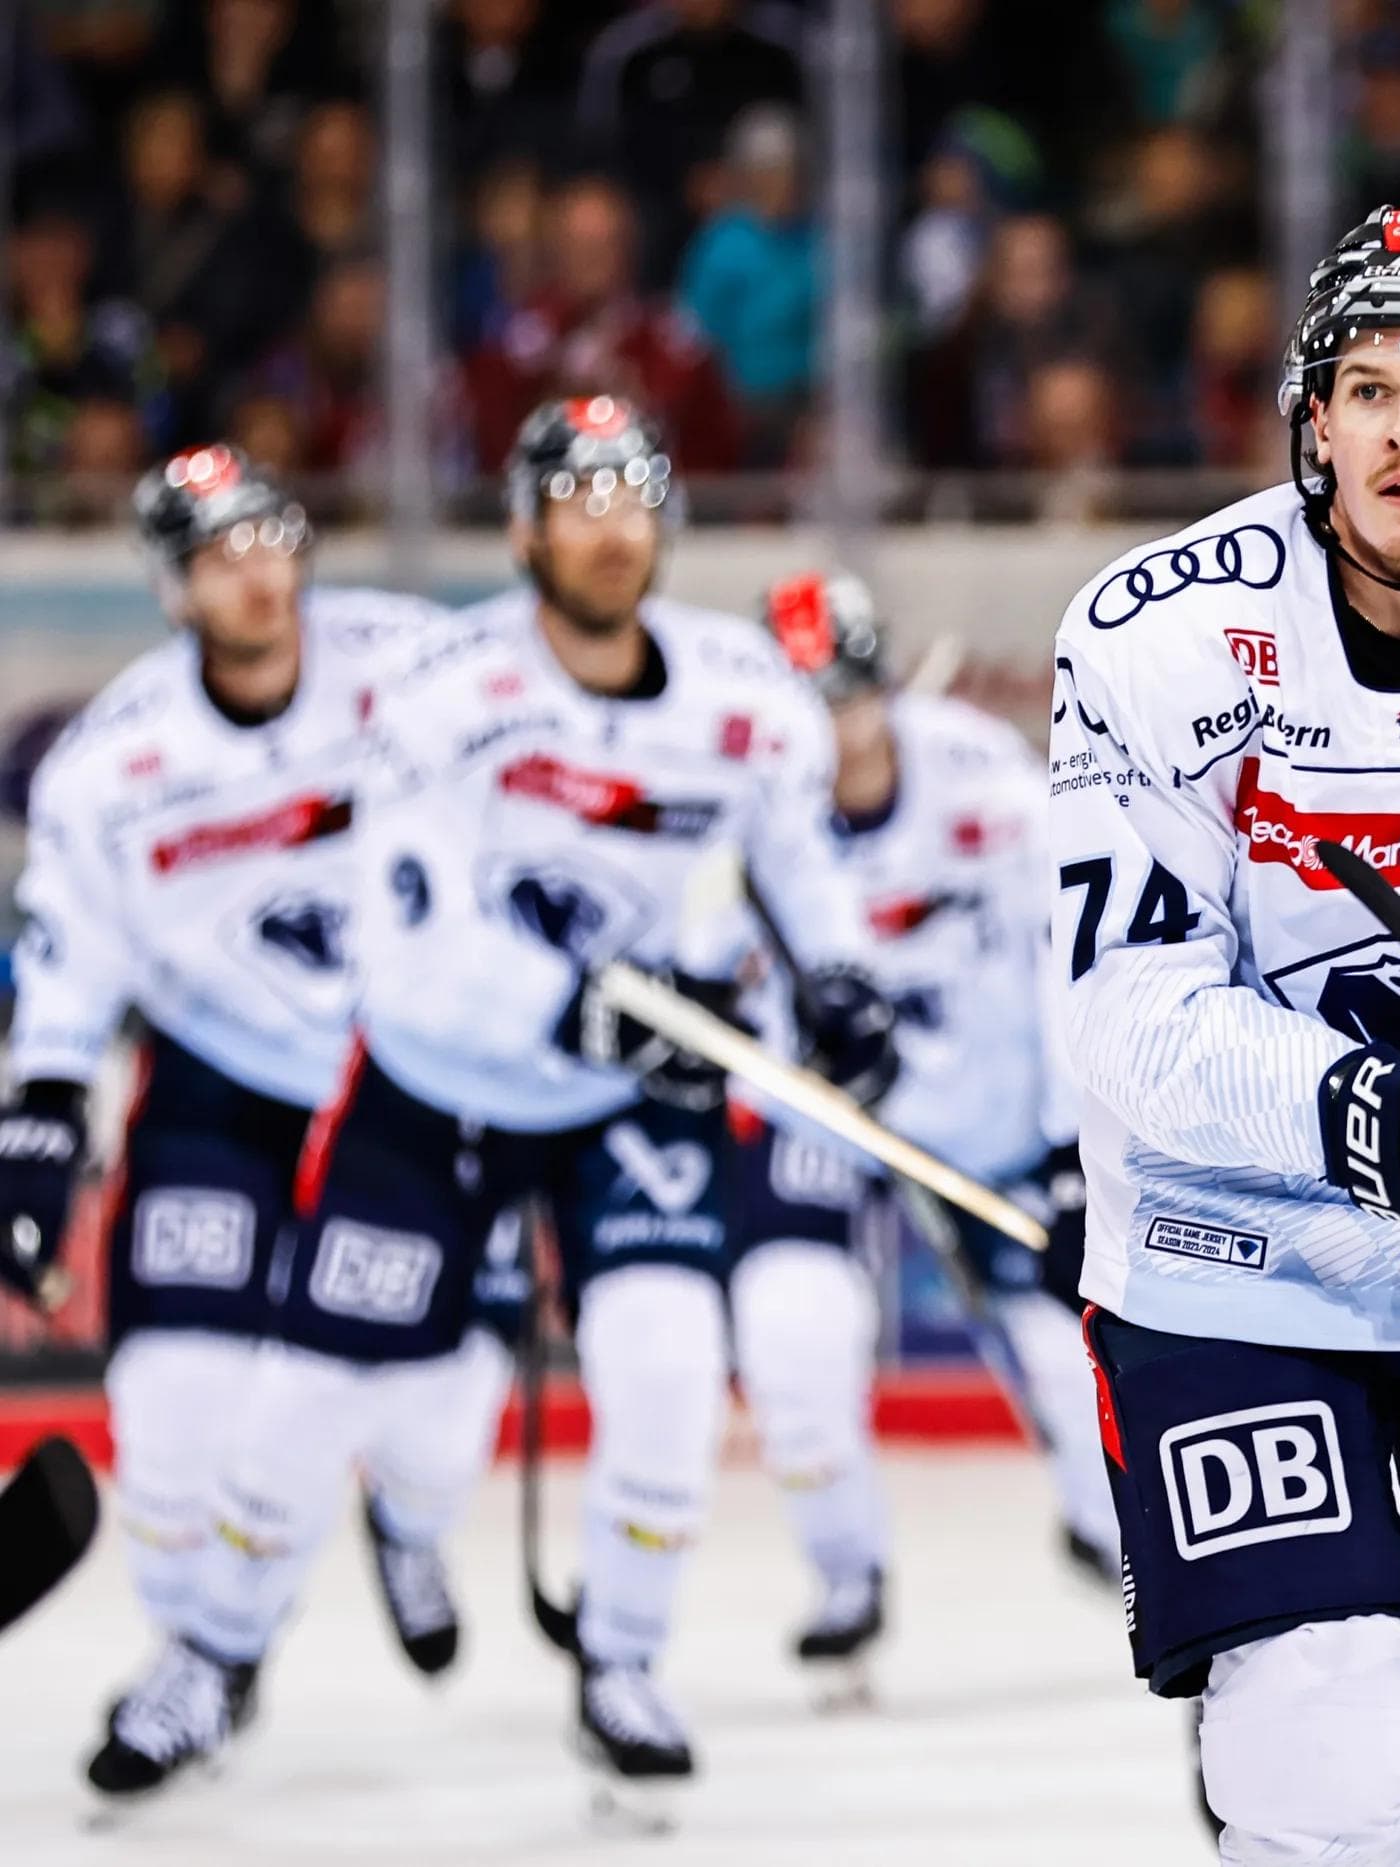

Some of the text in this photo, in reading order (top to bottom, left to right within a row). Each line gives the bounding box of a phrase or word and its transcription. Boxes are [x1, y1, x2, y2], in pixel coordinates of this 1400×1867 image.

[1060, 857, 1201, 981] 74
[1157, 1223, 1227, 1245] OFFICIAL GAME JERSEY
[1157, 1235, 1181, 1247] SEASON
[1180, 1425, 1328, 1535] DB
